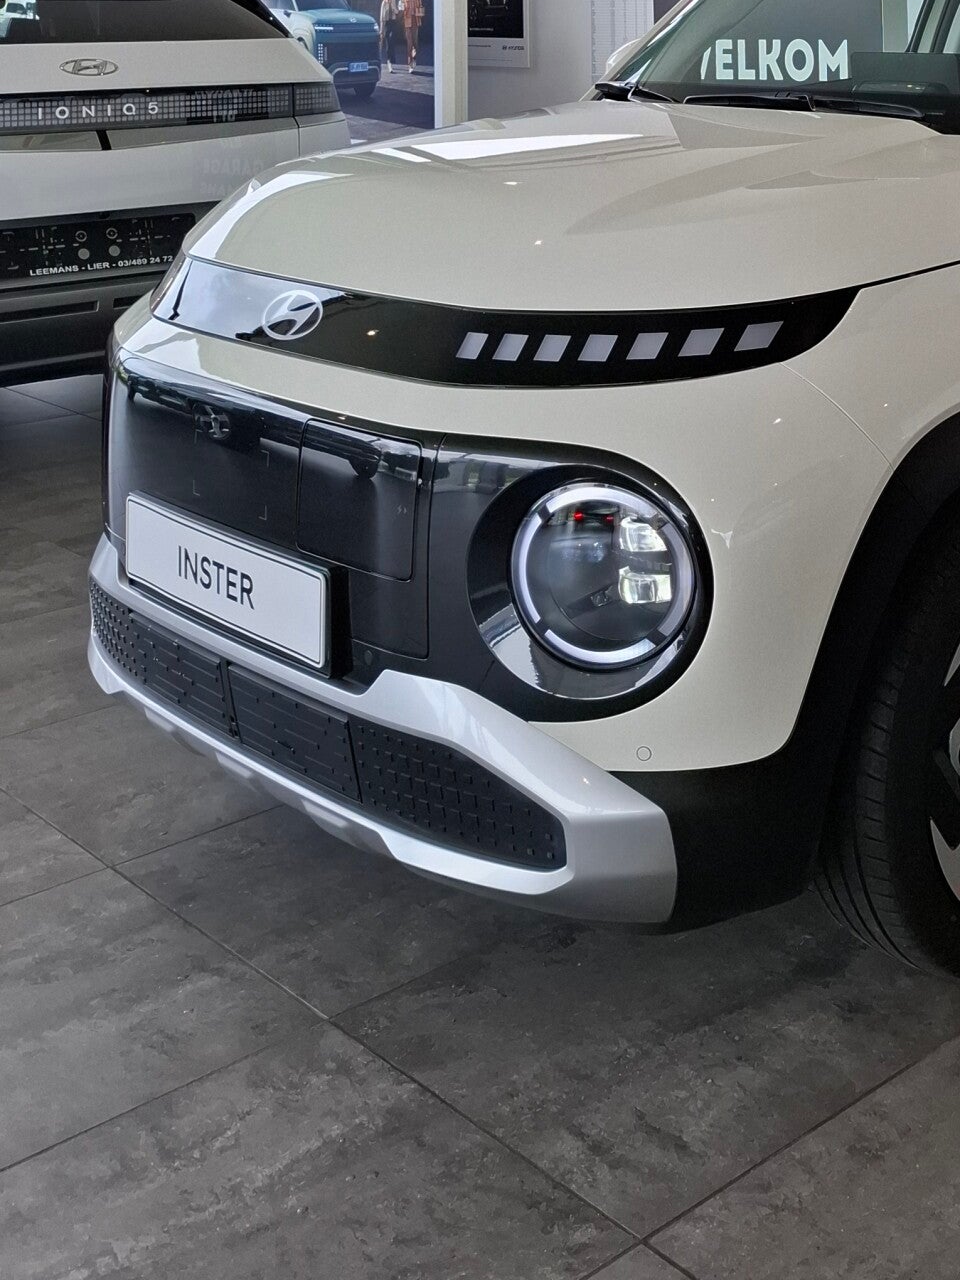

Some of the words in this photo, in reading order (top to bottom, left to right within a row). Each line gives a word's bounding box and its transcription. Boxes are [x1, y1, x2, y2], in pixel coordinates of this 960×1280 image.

[38, 103, 136, 120] IONIQ
[148, 101, 159, 114] 5
[29, 265, 79, 276] LEEMANS
[87, 261, 111, 271] LIER
[149, 256, 161, 264] 24
[162, 255, 174, 263] 72
[178, 544, 255, 610] INSTER
